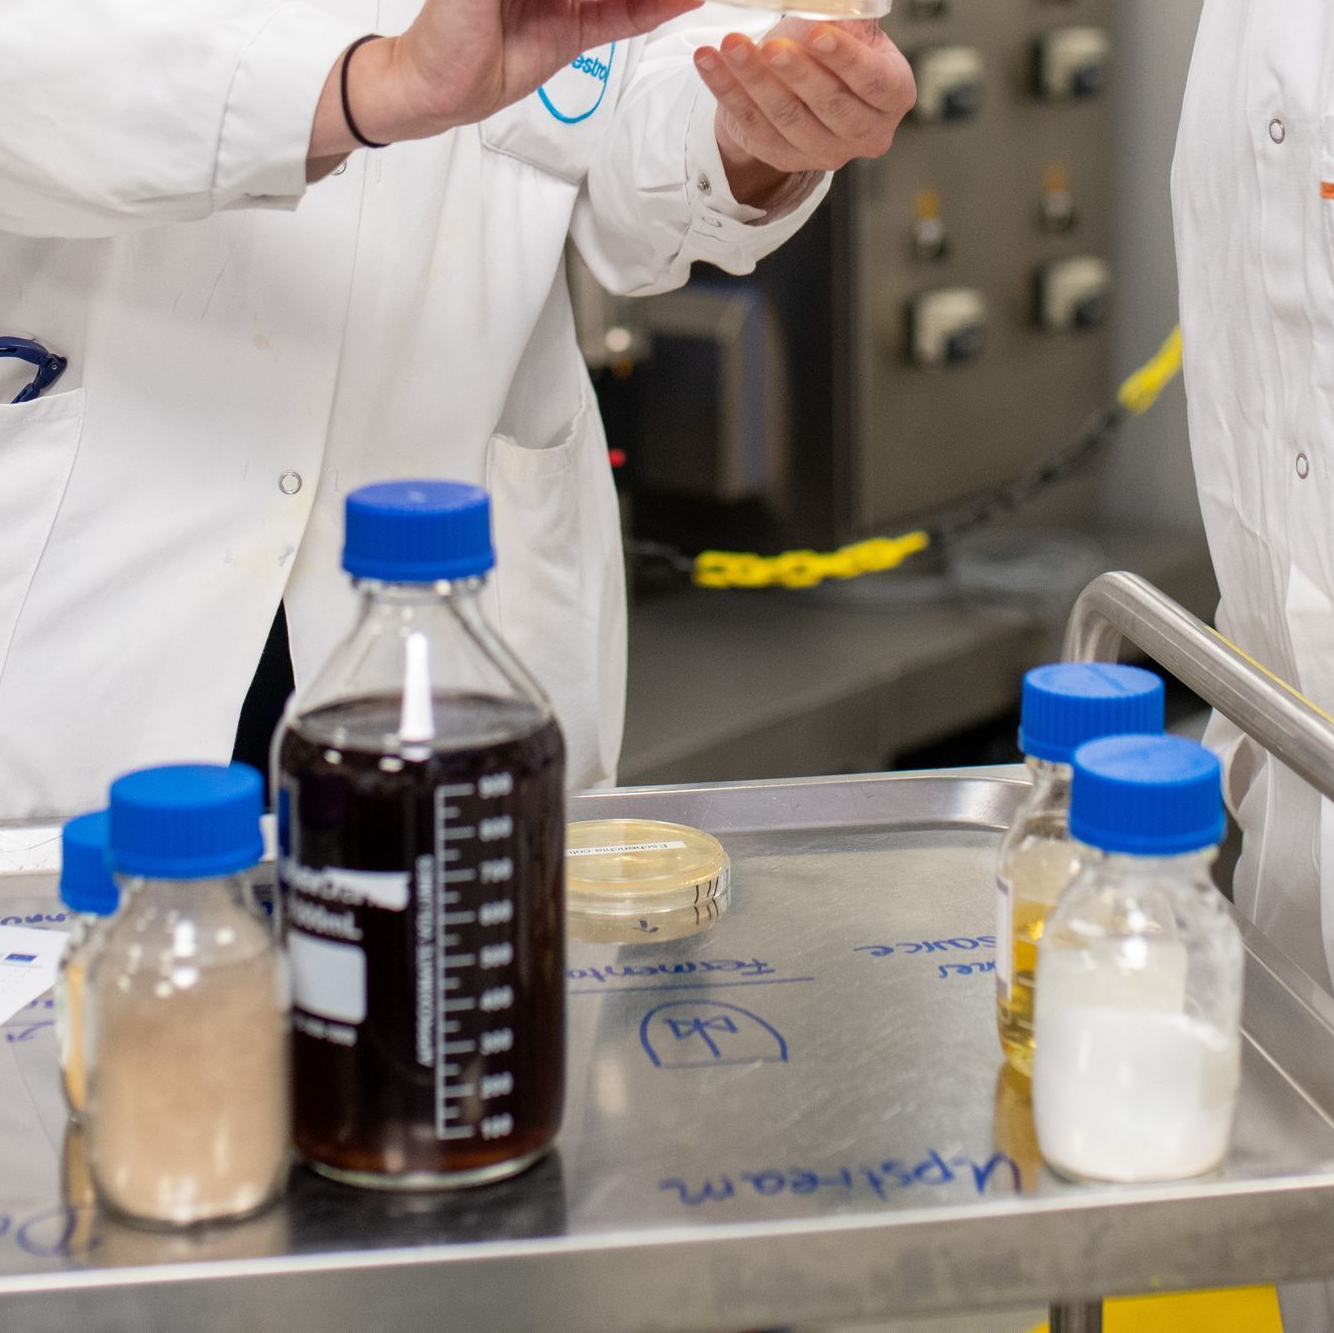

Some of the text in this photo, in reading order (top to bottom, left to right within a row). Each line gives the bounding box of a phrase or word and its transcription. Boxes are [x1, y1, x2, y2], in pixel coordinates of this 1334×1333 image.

[571, 54, 608, 81] estro
[479, 857, 514, 884] 700
[567, 958, 776, 983] Fermenta
[480, 1112, 514, 1141] 100
[657, 1147, 1022, 1207] Upstream
